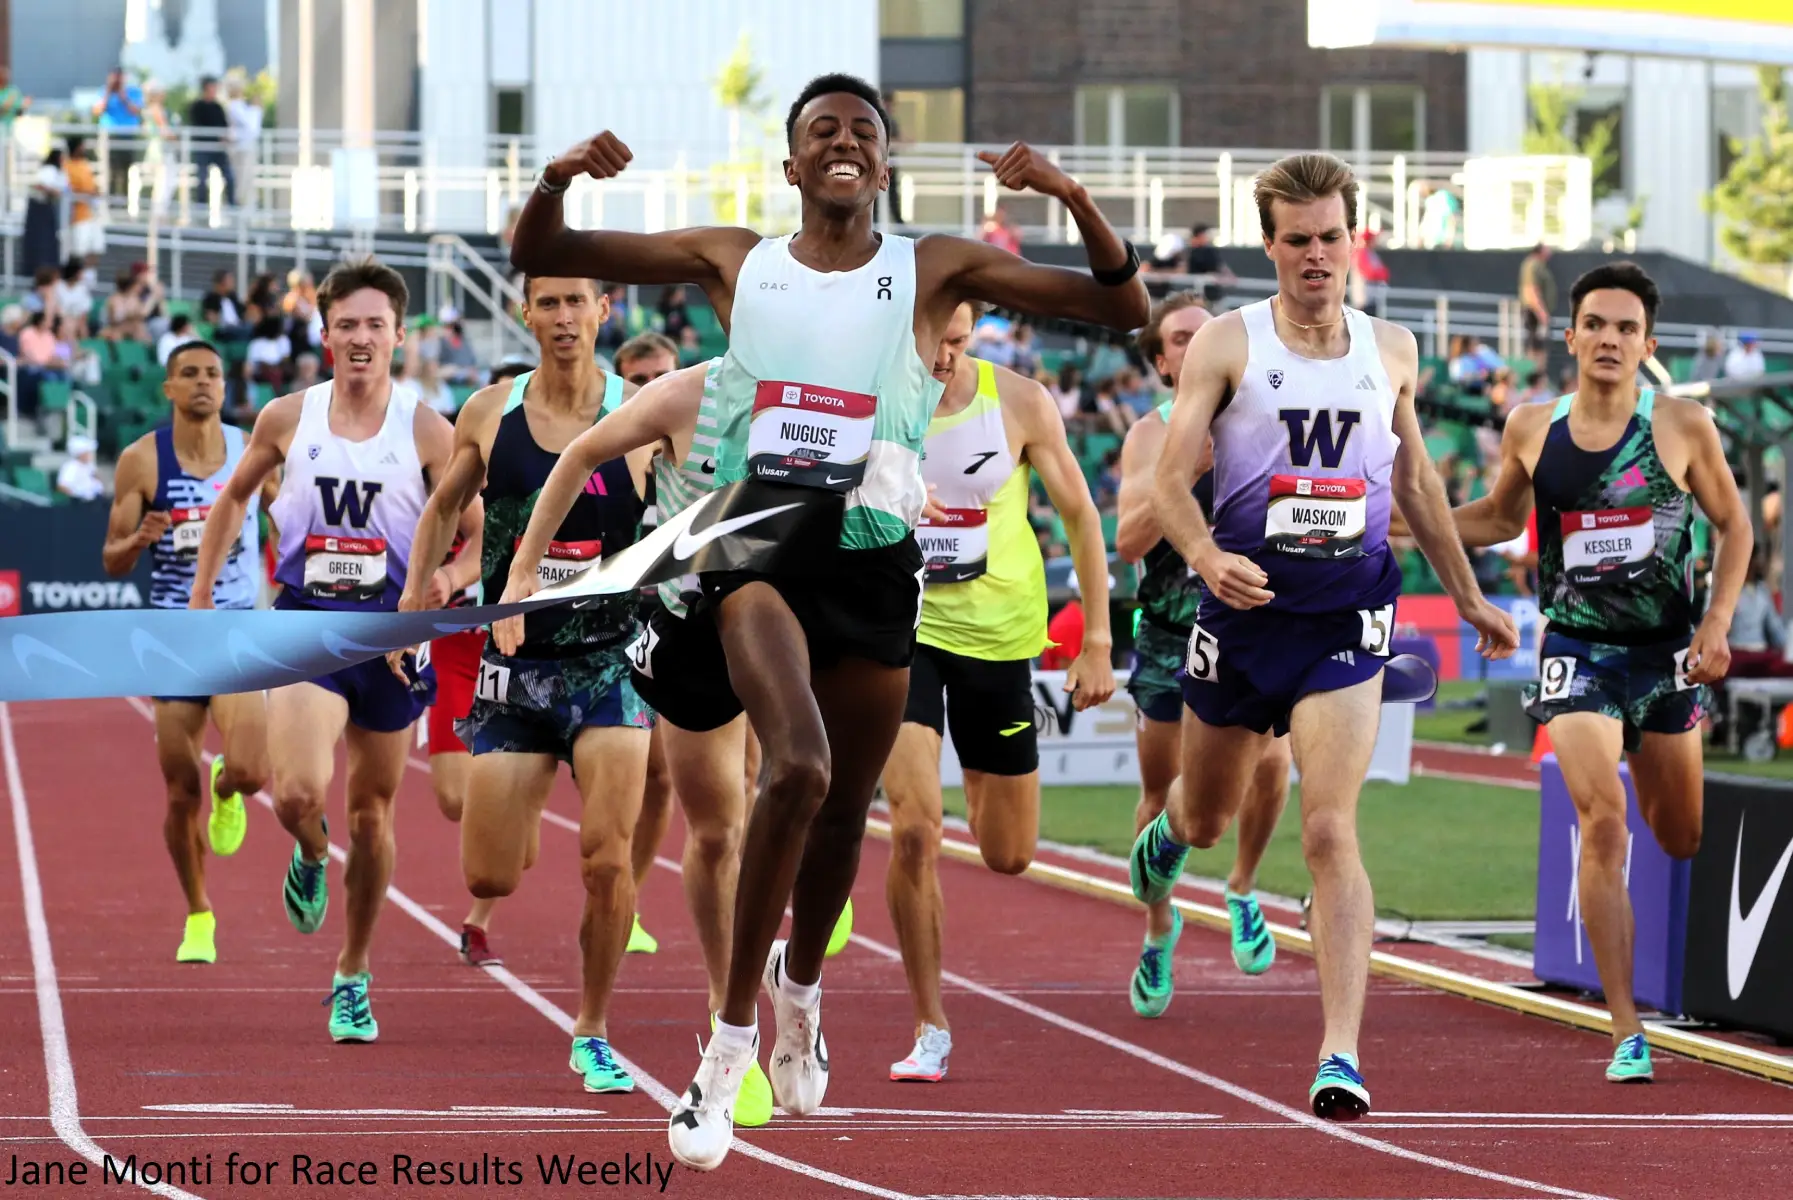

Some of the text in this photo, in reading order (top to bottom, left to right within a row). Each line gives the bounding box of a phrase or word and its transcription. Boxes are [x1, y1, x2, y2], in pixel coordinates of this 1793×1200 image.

[759, 282, 789, 291] OAC
[804, 393, 845, 408] TOYOTA
[780, 422, 838, 447] NUGUSE
[1278, 408, 1362, 470] W
[764, 468, 790, 478] USATF
[1314, 484, 1347, 493] TOYOTA
[314, 476, 383, 528] W
[1292, 507, 1347, 526] WASKOM
[1597, 514, 1630, 524] TOYOTA
[551, 546, 582, 556] TOYOTA
[920, 538, 959, 552] WYNNE
[1584, 538, 1632, 554] KESSLER
[329, 561, 363, 576] GREEN
[537, 565, 577, 581] PRAKE
[27, 581, 143, 608] TOYOTA
[1369, 605, 1387, 653] 5
[1194, 630, 1211, 678] 5
[478, 663, 501, 701] 11
[1545, 659, 1568, 695] 9
